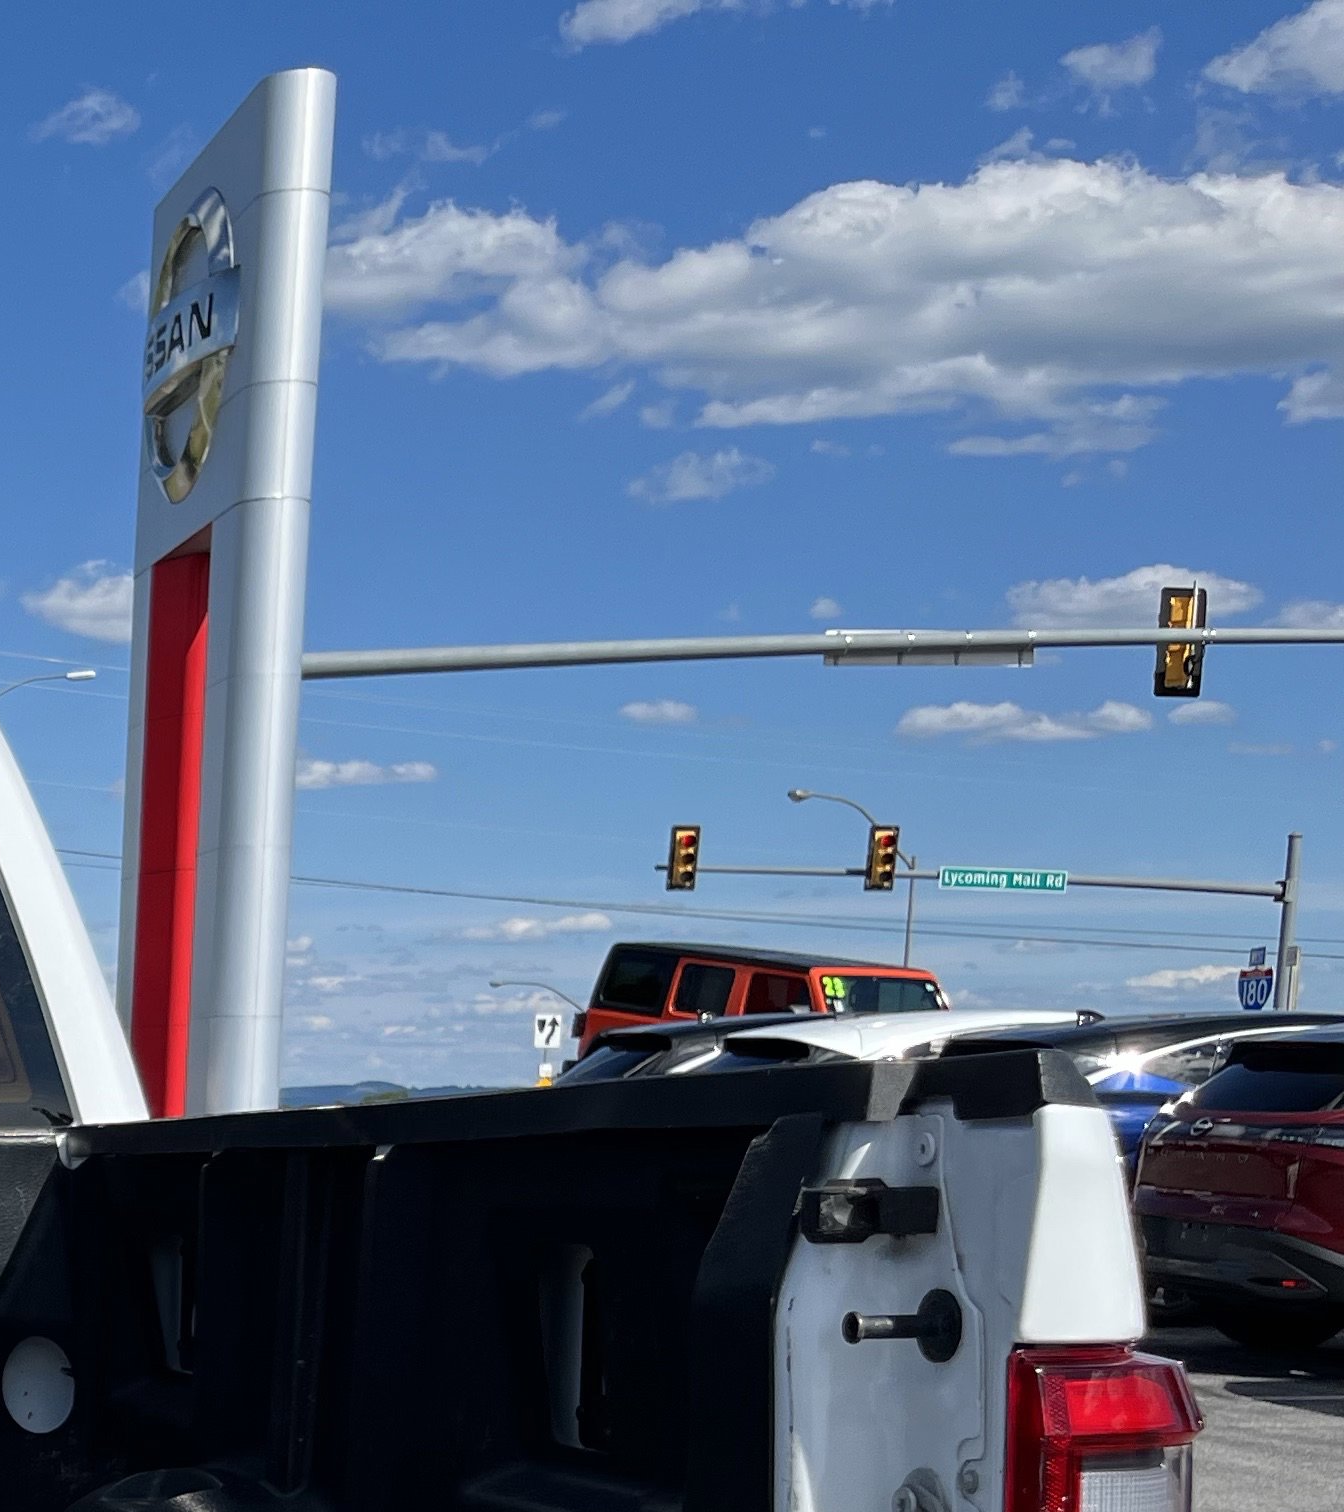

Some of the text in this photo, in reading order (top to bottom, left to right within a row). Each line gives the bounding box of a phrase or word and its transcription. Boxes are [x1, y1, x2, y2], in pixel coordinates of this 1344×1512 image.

[146, 293, 214, 380] SSAN
[944, 869, 1063, 889] Lycoming Mall Rd
[1242, 979, 1268, 1007] 180
